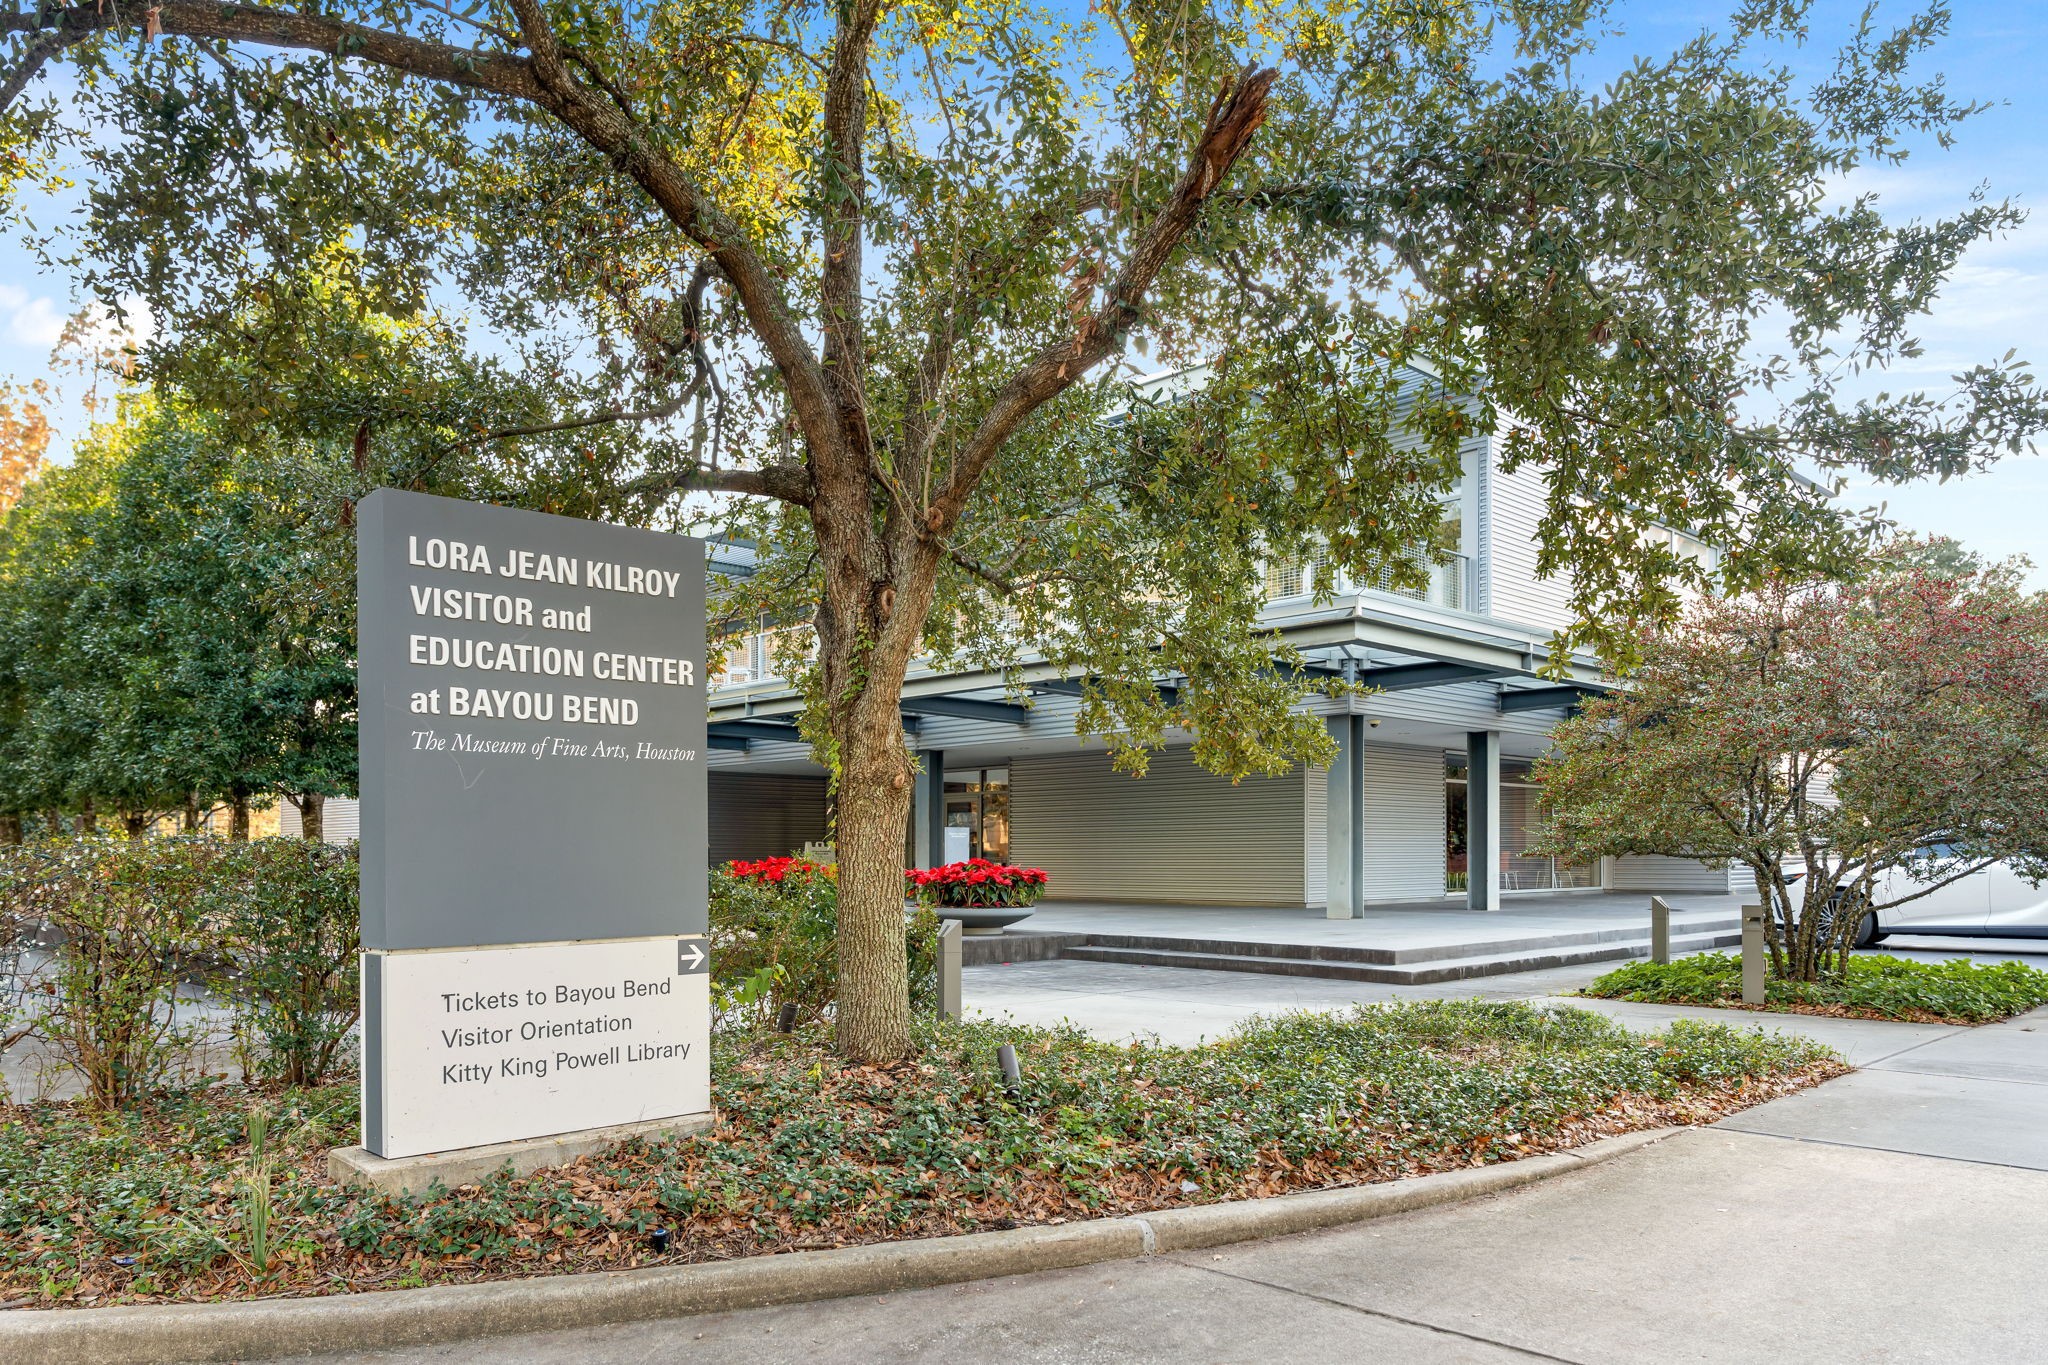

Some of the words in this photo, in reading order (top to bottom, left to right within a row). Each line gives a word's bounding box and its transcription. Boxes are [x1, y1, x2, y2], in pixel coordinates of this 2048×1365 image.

[409, 536, 491, 575] LORA
[499, 550, 577, 585] JEAN
[586, 560, 680, 598] KILROY
[409, 585, 533, 626] VISITOR
[541, 605, 591, 632] and
[409, 634, 584, 677] EDUCATION
[592, 651, 694, 686] CENTER
[410, 688, 440, 714] at
[449, 686, 553, 721] BAYOU
[562, 694, 639, 725] BEND
[411, 730, 446, 751] The
[451, 733, 526, 755] Museum
[531, 736, 549, 760] of
[551, 738, 587, 757] Fine
[591, 740, 629, 761] Arts,
[636, 742, 695, 761] Houston
[441, 991, 519, 1013] Tickets
[526, 989, 547, 1006] to
[555, 984, 615, 1005] Bayou
[623, 977, 671, 998] Bend
[441, 1026, 513, 1048] Visitor
[520, 1015, 632, 1040] Orientation
[443, 1063, 493, 1084] Kitty
[501, 1056, 547, 1078] King
[556, 1046, 619, 1071] Powell
[627, 1043, 691, 1062] Library
